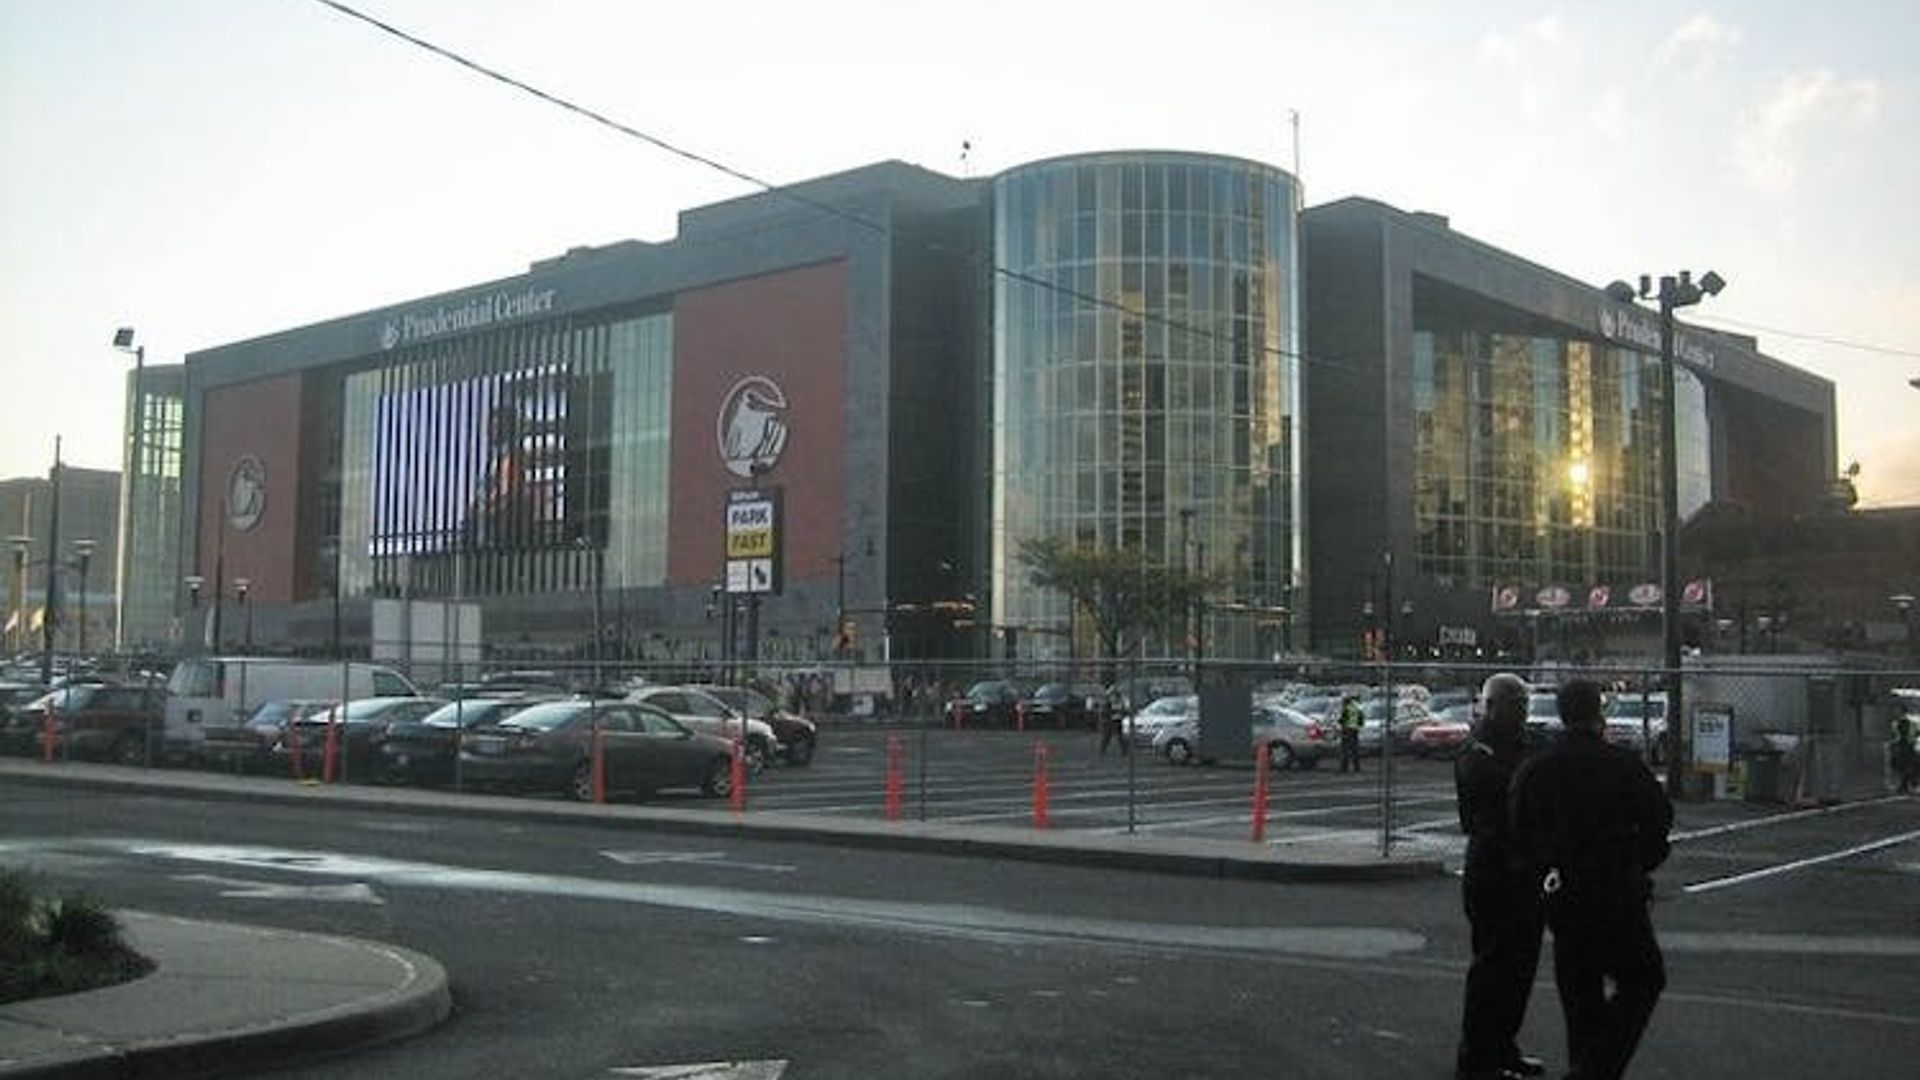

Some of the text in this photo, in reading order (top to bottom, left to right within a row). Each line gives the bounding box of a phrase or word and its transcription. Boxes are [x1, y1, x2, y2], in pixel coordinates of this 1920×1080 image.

[403, 287, 557, 340] Prudential Center
[732, 508, 769, 525] PARK
[732, 532, 767, 550] FAST
